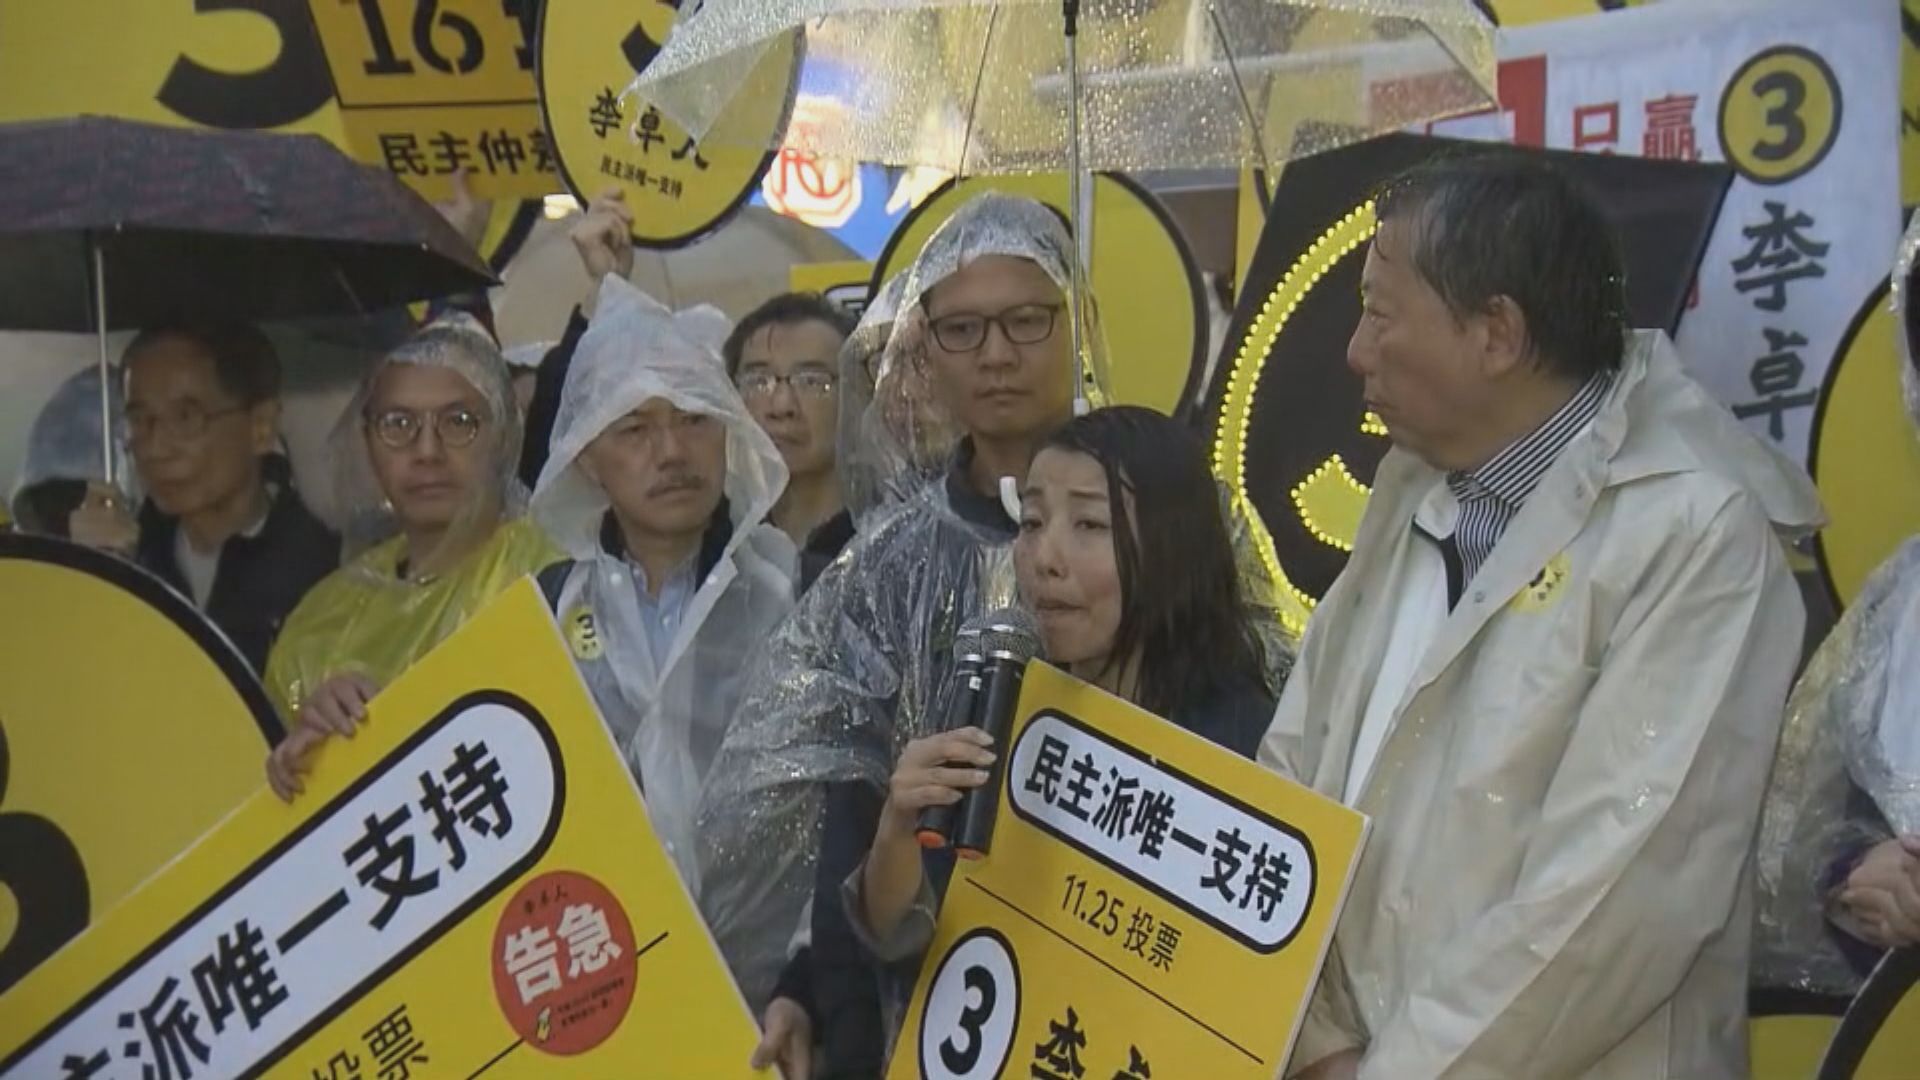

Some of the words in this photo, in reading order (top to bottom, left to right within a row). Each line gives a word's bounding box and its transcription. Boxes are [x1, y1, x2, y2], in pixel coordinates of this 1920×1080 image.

[1751, 72, 1806, 161] 3
[1731, 202, 1831, 442] 李卓
[1024, 734, 1293, 923] 民主派唯一支持
[60, 740, 514, 1080] 派唯一支持
[503, 903, 623, 1006] 告急
[1061, 874, 1123, 938] 11.25
[1123, 906, 1183, 973] 投票
[939, 965, 997, 1075] 3
